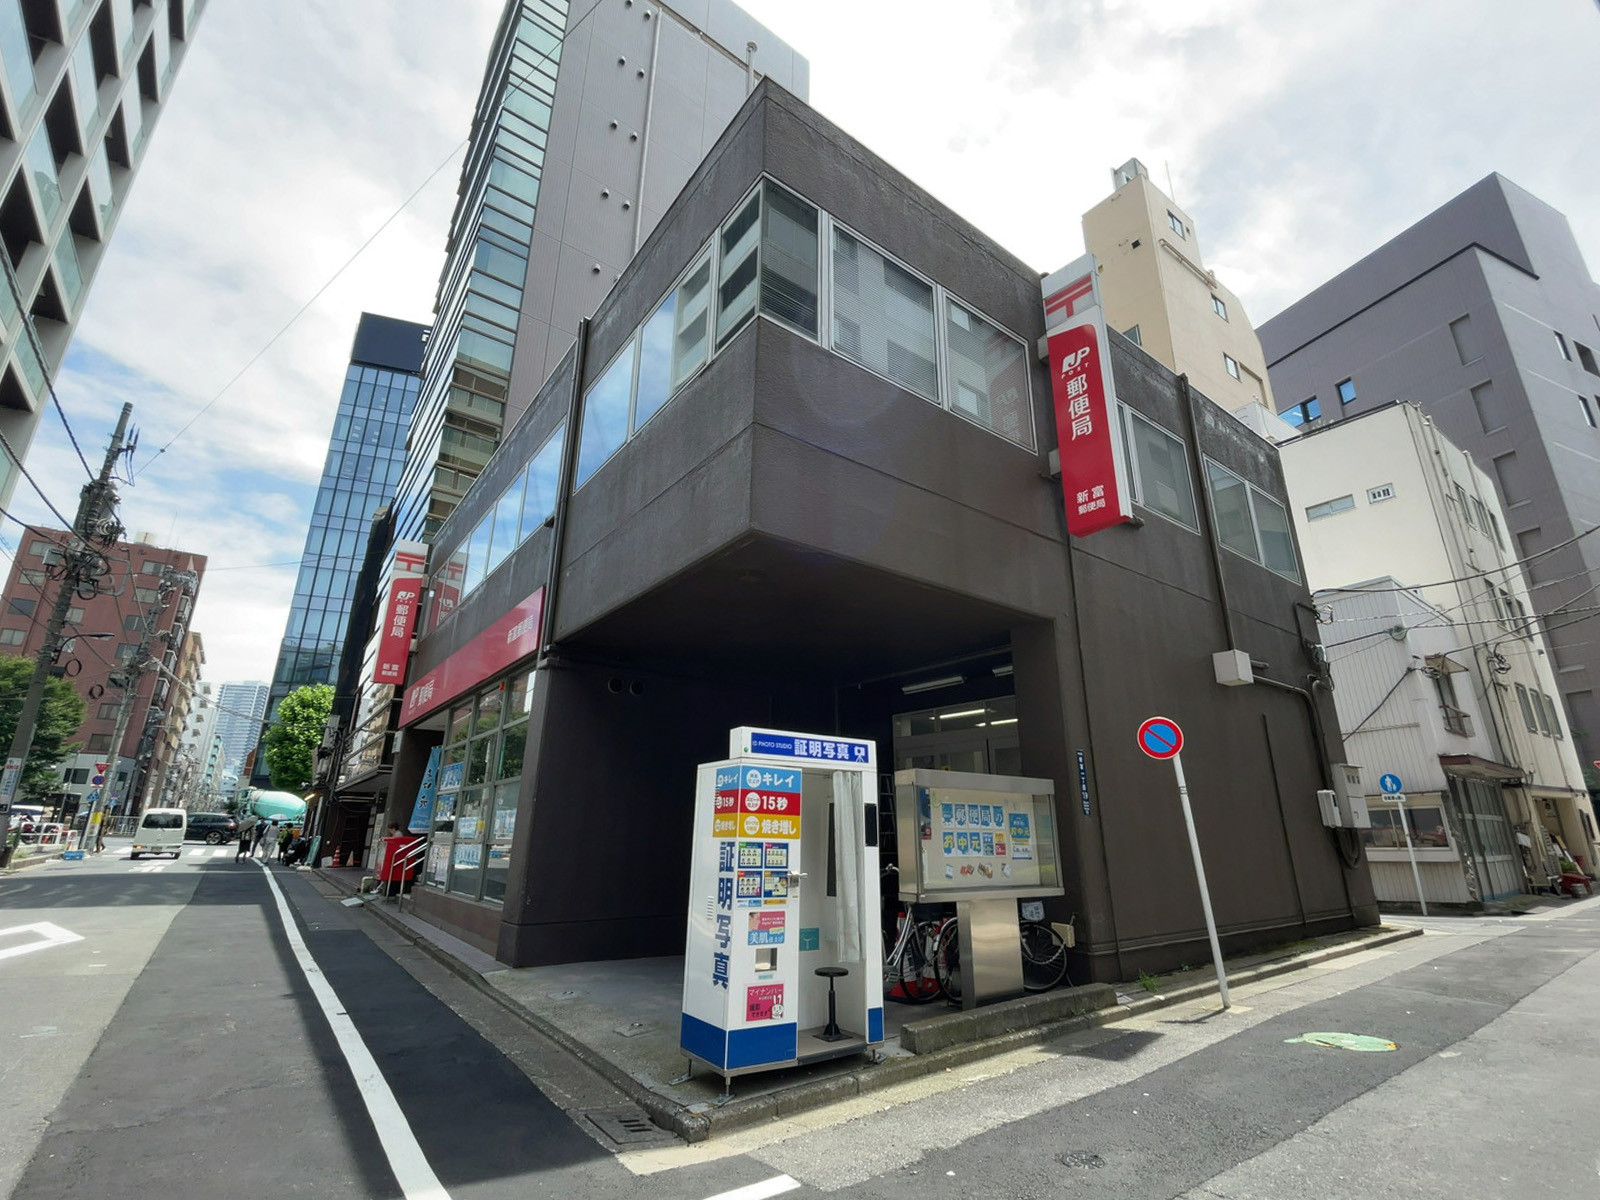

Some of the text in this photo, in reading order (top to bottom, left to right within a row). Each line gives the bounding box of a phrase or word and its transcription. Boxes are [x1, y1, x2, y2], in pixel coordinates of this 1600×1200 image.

[1061, 362, 1089, 379] POST
[1066, 374, 1092, 441] 郵便局
[1077, 485, 1104, 504] 新富
[1078, 498, 1106, 515] 郵便局
[390, 604, 409, 638] 郵便局
[775, 742, 793, 750] STUDIO
[794, 739, 849, 760] 証明写真
[763, 772, 794, 788] キレイ
[762, 796, 788, 811] 15秒
[955, 808, 1004, 825] 郵便局の
[761, 819, 797, 835] 焼き増し
[943, 835, 980, 850] お中元
[712, 841, 736, 990] 証明写真
